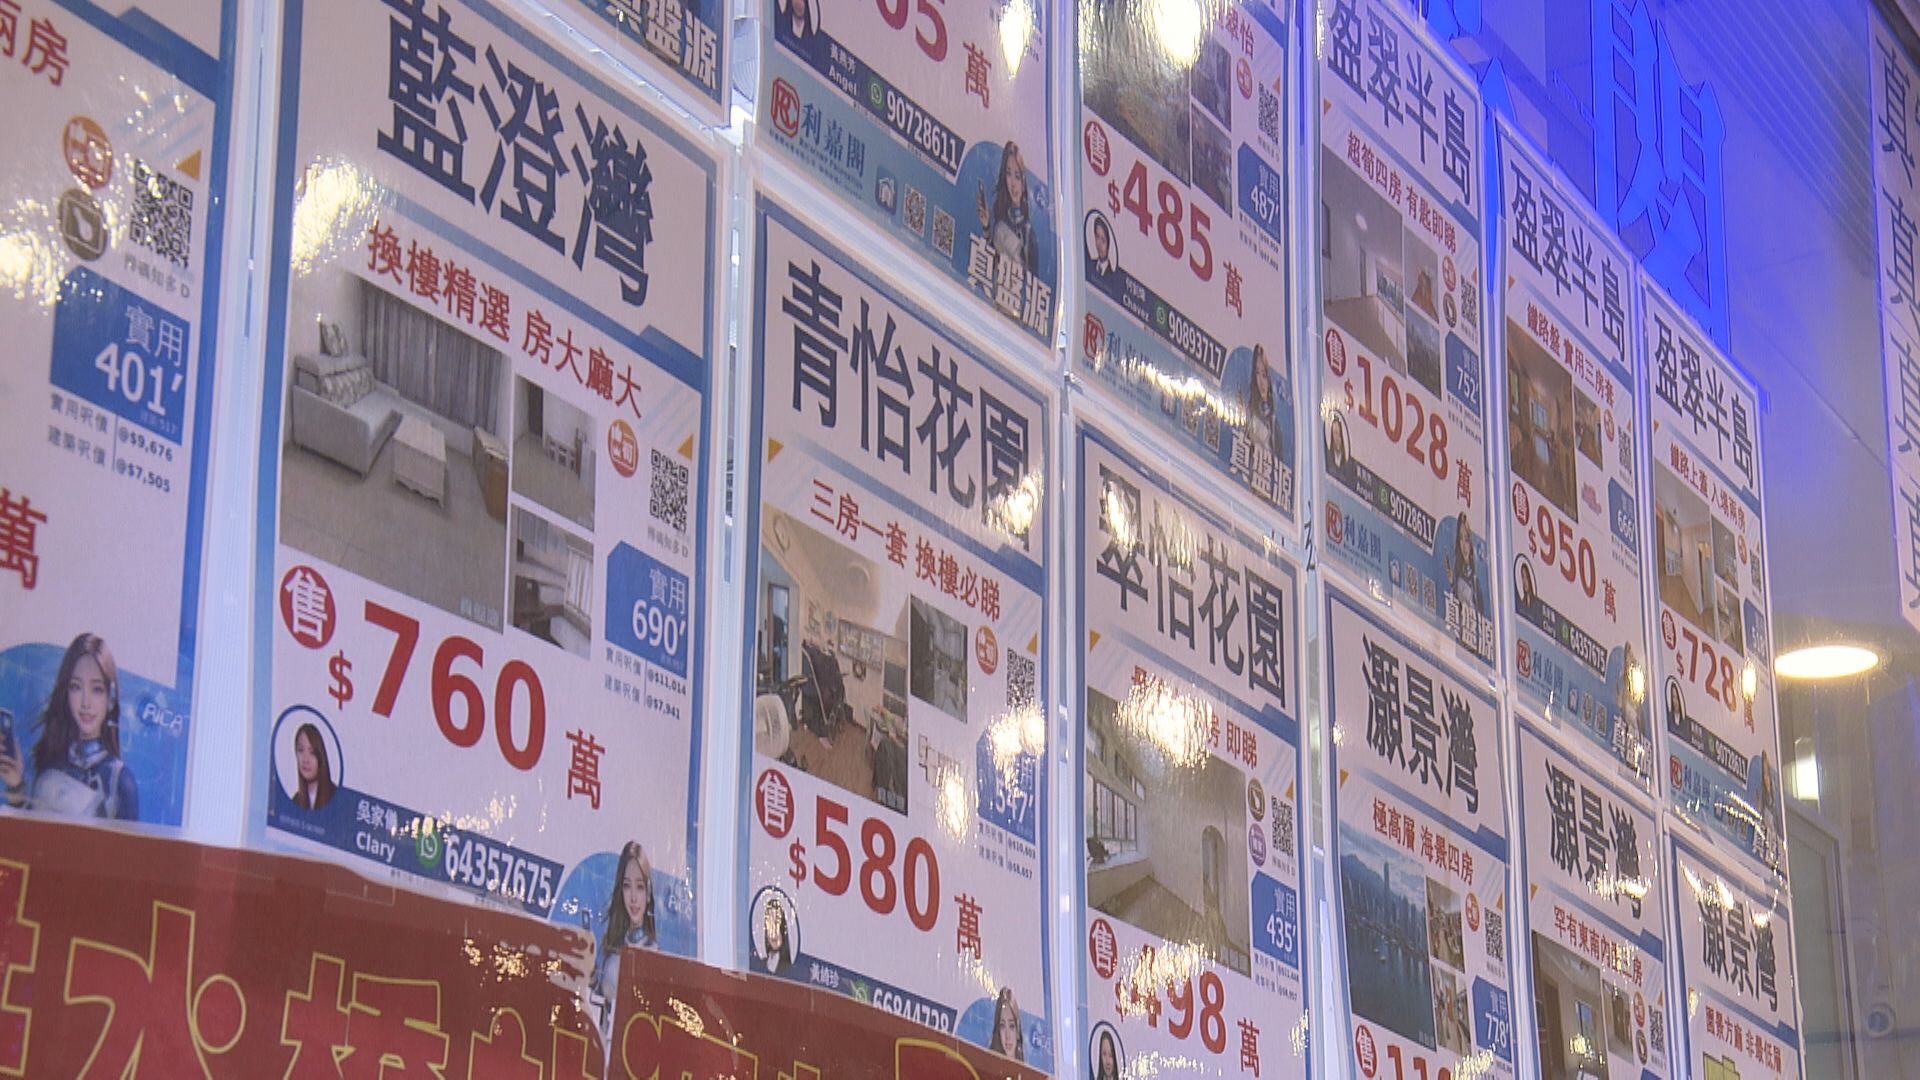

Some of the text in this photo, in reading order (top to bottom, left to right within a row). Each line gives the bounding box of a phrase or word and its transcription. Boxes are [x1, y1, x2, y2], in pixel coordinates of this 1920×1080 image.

[828, 65, 857, 96] Angel
[963, 41, 992, 109] 萬
[1328, 0, 1471, 205] 盈翠半島
[377, 0, 654, 307] 藍澄灣
[802, 103, 864, 177] 利嘉閣
[887, 90, 957, 170] 90728611
[1086, 123, 1108, 175] 售
[1108, 159, 1213, 282] $485
[1223, 260, 1242, 319] 萬
[1251, 185, 1278, 224] 487'
[1347, 131, 1456, 254] 超筍四房 有匙即睇
[967, 232, 1051, 336] 真盤源
[1511, 160, 1625, 362] 盈翠半島
[126, 304, 183, 368] 實用
[368, 220, 642, 418] 換樓精選 房大廳大
[1123, 295, 1150, 322] Chavez
[1168, 310, 1221, 373] 90893717
[95, 341, 183, 417] 401'
[783, 260, 1030, 552] 青怡花園
[1327, 331, 1344, 374] 售
[1344, 355, 1448, 480] $1028
[1456, 459, 1473, 509] 萬
[1457, 365, 1478, 404] 752'
[1655, 313, 1753, 488] 盈翠半島
[1230, 428, 1291, 513] 真盤源
[810, 479, 1000, 622] 三房一套 換樓必睇
[1390, 490, 1432, 543] 90728611
[1515, 482, 1528, 524] 售
[1529, 505, 1596, 598] $950
[1602, 576, 1616, 624] 萬
[632, 599, 685, 656] 690'
[650, 568, 685, 615] 實用
[1097, 462, 1285, 709] 翠怡花園
[1444, 590, 1494, 663] 真盤源
[285, 569, 606, 810] 售 $760 萬
[1676, 627, 1736, 713] $728
[1226, 720, 1258, 769] 即睇
[1362, 633, 1479, 815] 灝景灣
[356, 831, 396, 863] Clary
[444, 834, 551, 908] 64357675
[759, 771, 983, 959] 售 $580 萬
[1372, 797, 1474, 887] 極高層 海景四房
[1546, 757, 1641, 920] 灝景灣
[1267, 913, 1296, 953] 435'
[1092, 921, 1114, 973] 售
[1237, 1018, 1260, 1078] 萬
[1485, 1012, 1508, 1048] 778'
[1357, 1027, 1373, 1072] 售
